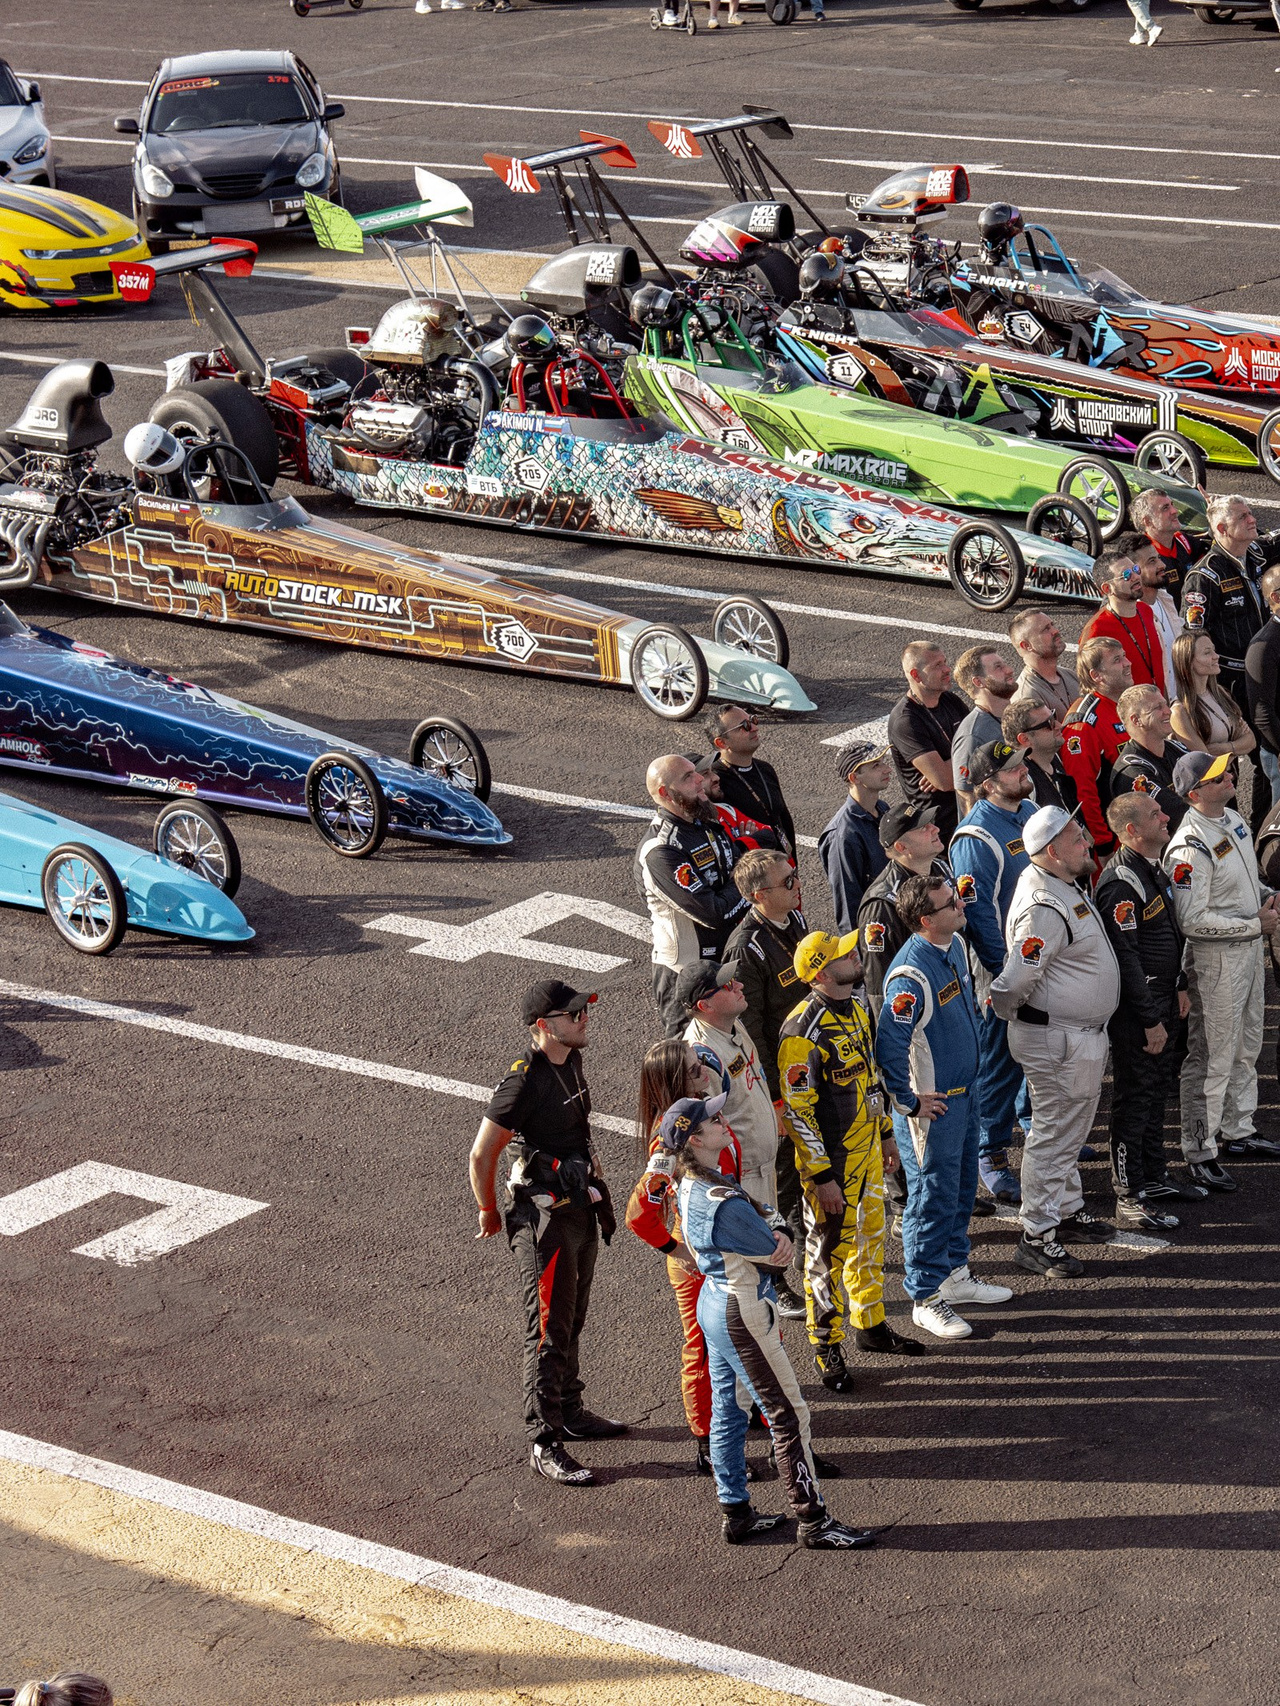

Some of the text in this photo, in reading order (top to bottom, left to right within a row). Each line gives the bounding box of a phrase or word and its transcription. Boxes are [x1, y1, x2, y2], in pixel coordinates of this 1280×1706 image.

[928, 170, 955, 182] MAX
[752, 205, 780, 217] MAX
[749, 215, 776, 227] RIDE
[748, 225, 774, 233] MOTORSPORT
[589, 251, 619, 266] MAX
[586, 263, 616, 277] RIDE
[118, 274, 150, 290] 357M
[585, 275, 614, 284] MOTORSPORT
[1019, 322, 1031, 333] 54
[808, 329, 859, 346] NIGHT
[840, 366, 853, 377] 11
[1077, 400, 1152, 426] МОСКОВСКИЙ
[501, 412, 535, 431] AKIMOV
[1078, 419, 1115, 438] СПОРТ
[522, 468, 542, 479] 705
[479, 481, 498, 493] ВТБ
[138, 497, 175, 511] Васильев
[225, 570, 403, 616] AUTOSTOCK_MSK
[504, 634, 524, 647] 700
[833, 1061, 864, 1080] RDRC
[674, 1115, 691, 1132] 33
